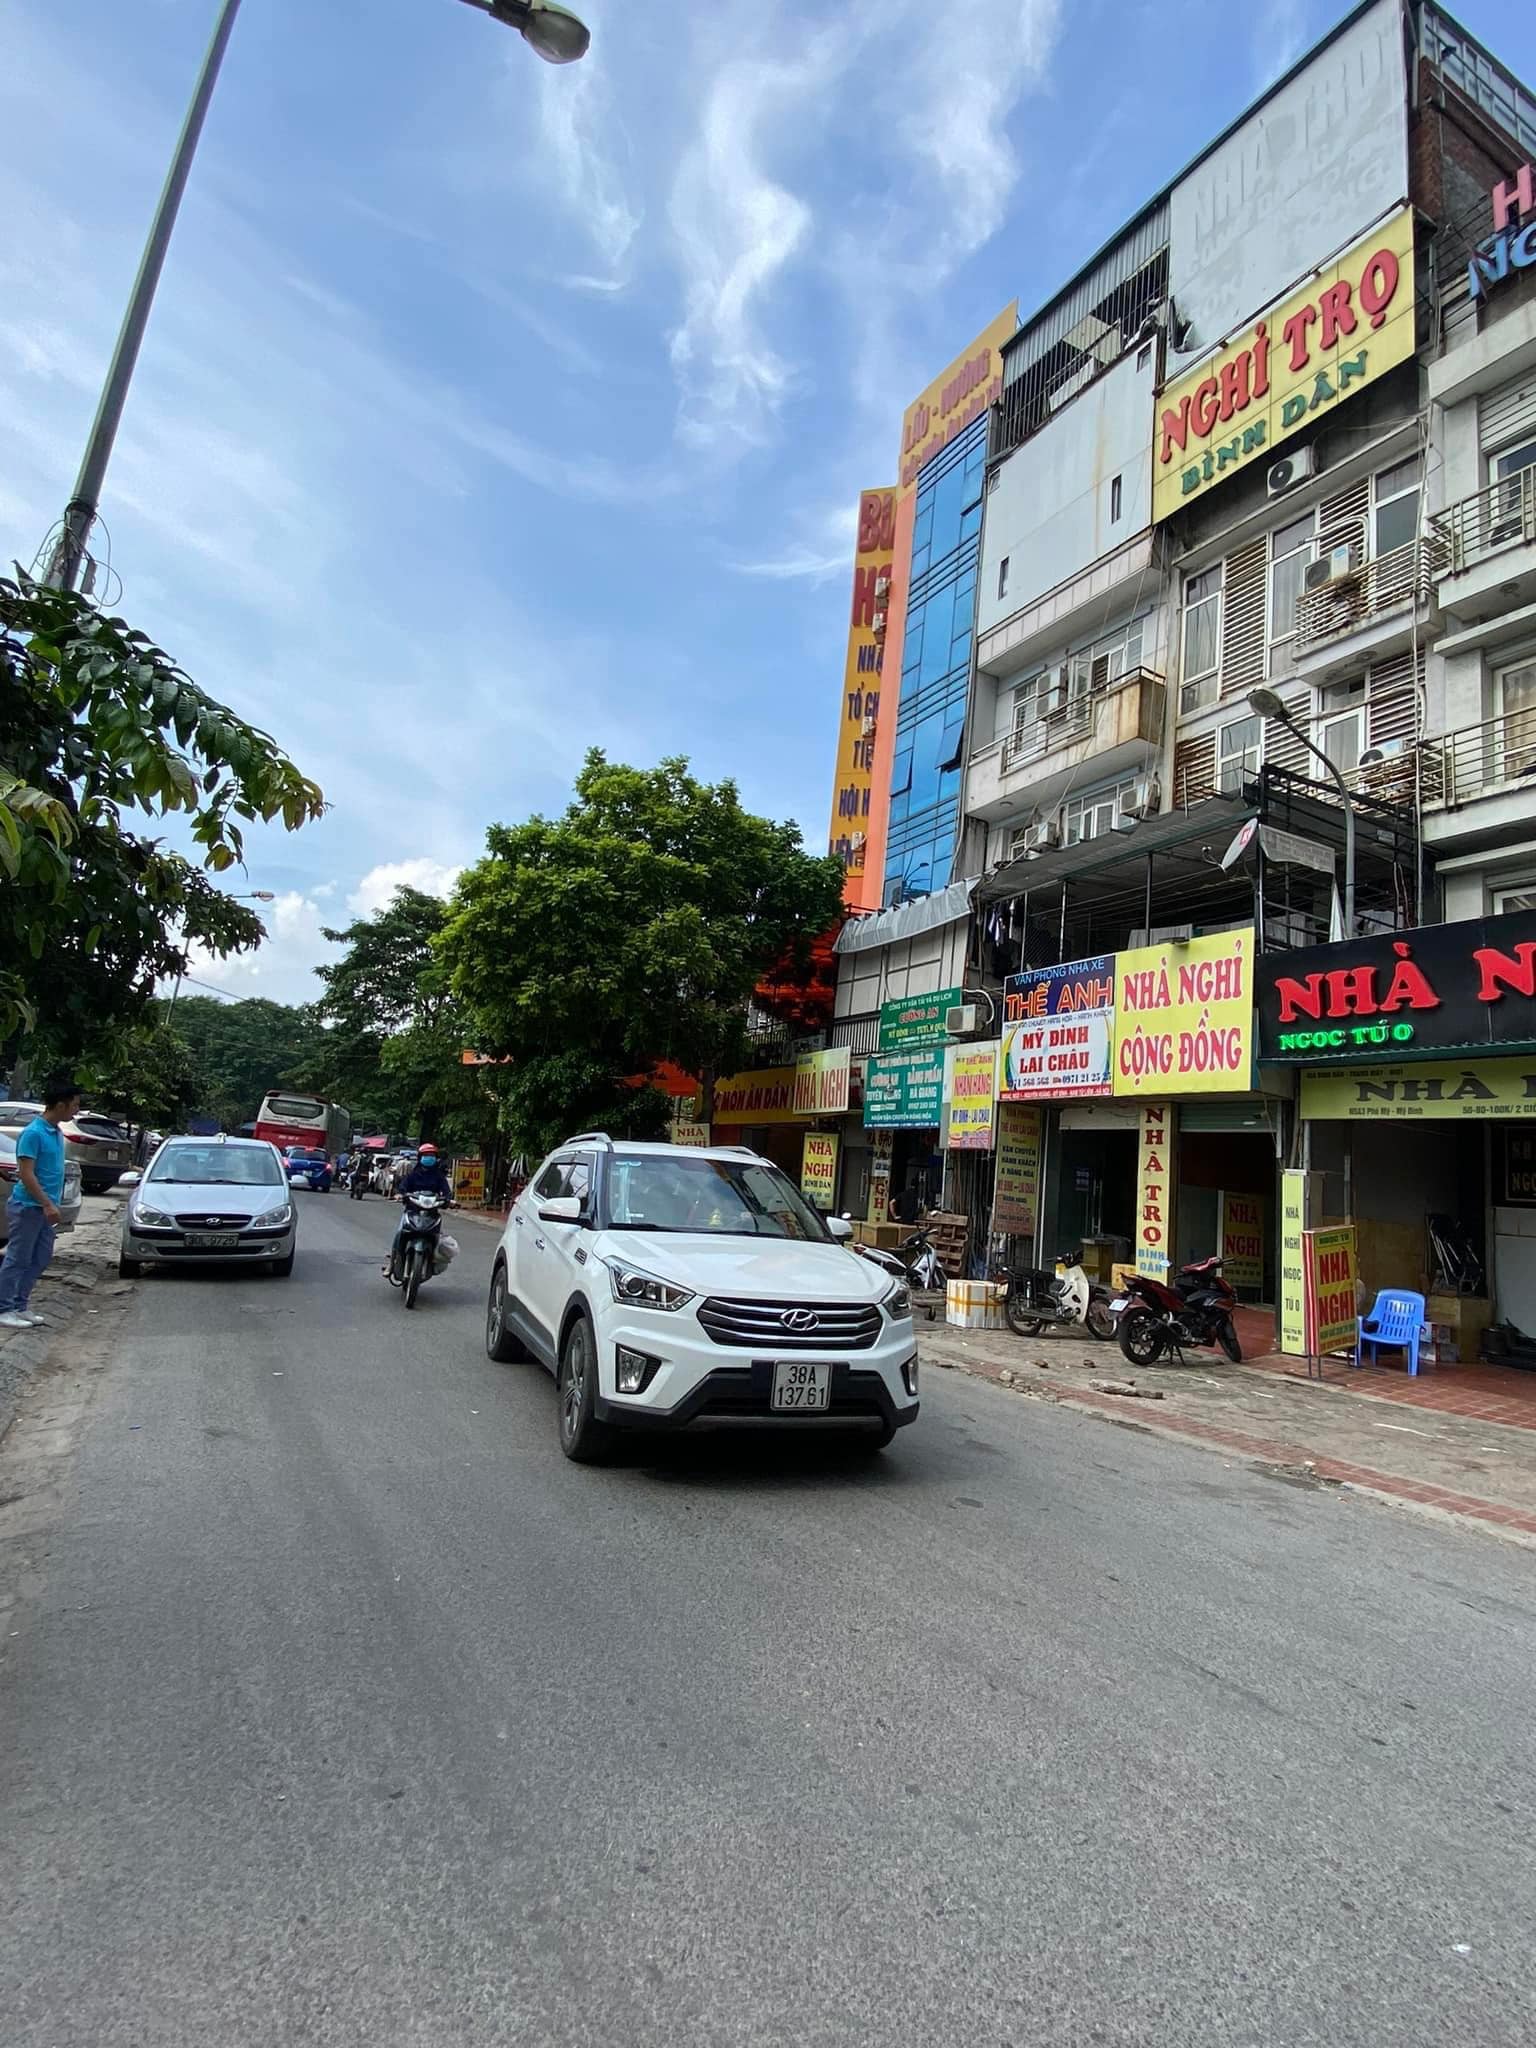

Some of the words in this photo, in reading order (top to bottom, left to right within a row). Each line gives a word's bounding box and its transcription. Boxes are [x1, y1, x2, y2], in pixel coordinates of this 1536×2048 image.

[1160, 321, 1271, 464] NGHỈ
[1282, 248, 1400, 373] TRỌ
[1181, 417, 1267, 496] BÌNH
[1280, 349, 1370, 429] DÂN
[1178, 938, 1244, 1006] NGHỈ
[1275, 942, 1441, 1023] NHÀ
[1006, 980, 1051, 1021] THẾ
[1056, 975, 1113, 1014] ANH
[1023, 1027, 1044, 1050] MỸ
[1049, 1024, 1089, 1047] ĐÌNH
[1119, 1024, 1173, 1087] CỘNG
[1178, 1008, 1242, 1073] ĐỒNG
[1020, 1056, 1043, 1074] LAI
[1048, 1048, 1090, 1072] CHÂU
[1354, 1071, 1499, 1102] NHÀ
[1319, 1247, 1351, 1286] NHÀ
[788, 1366, 816, 1385] 38A
